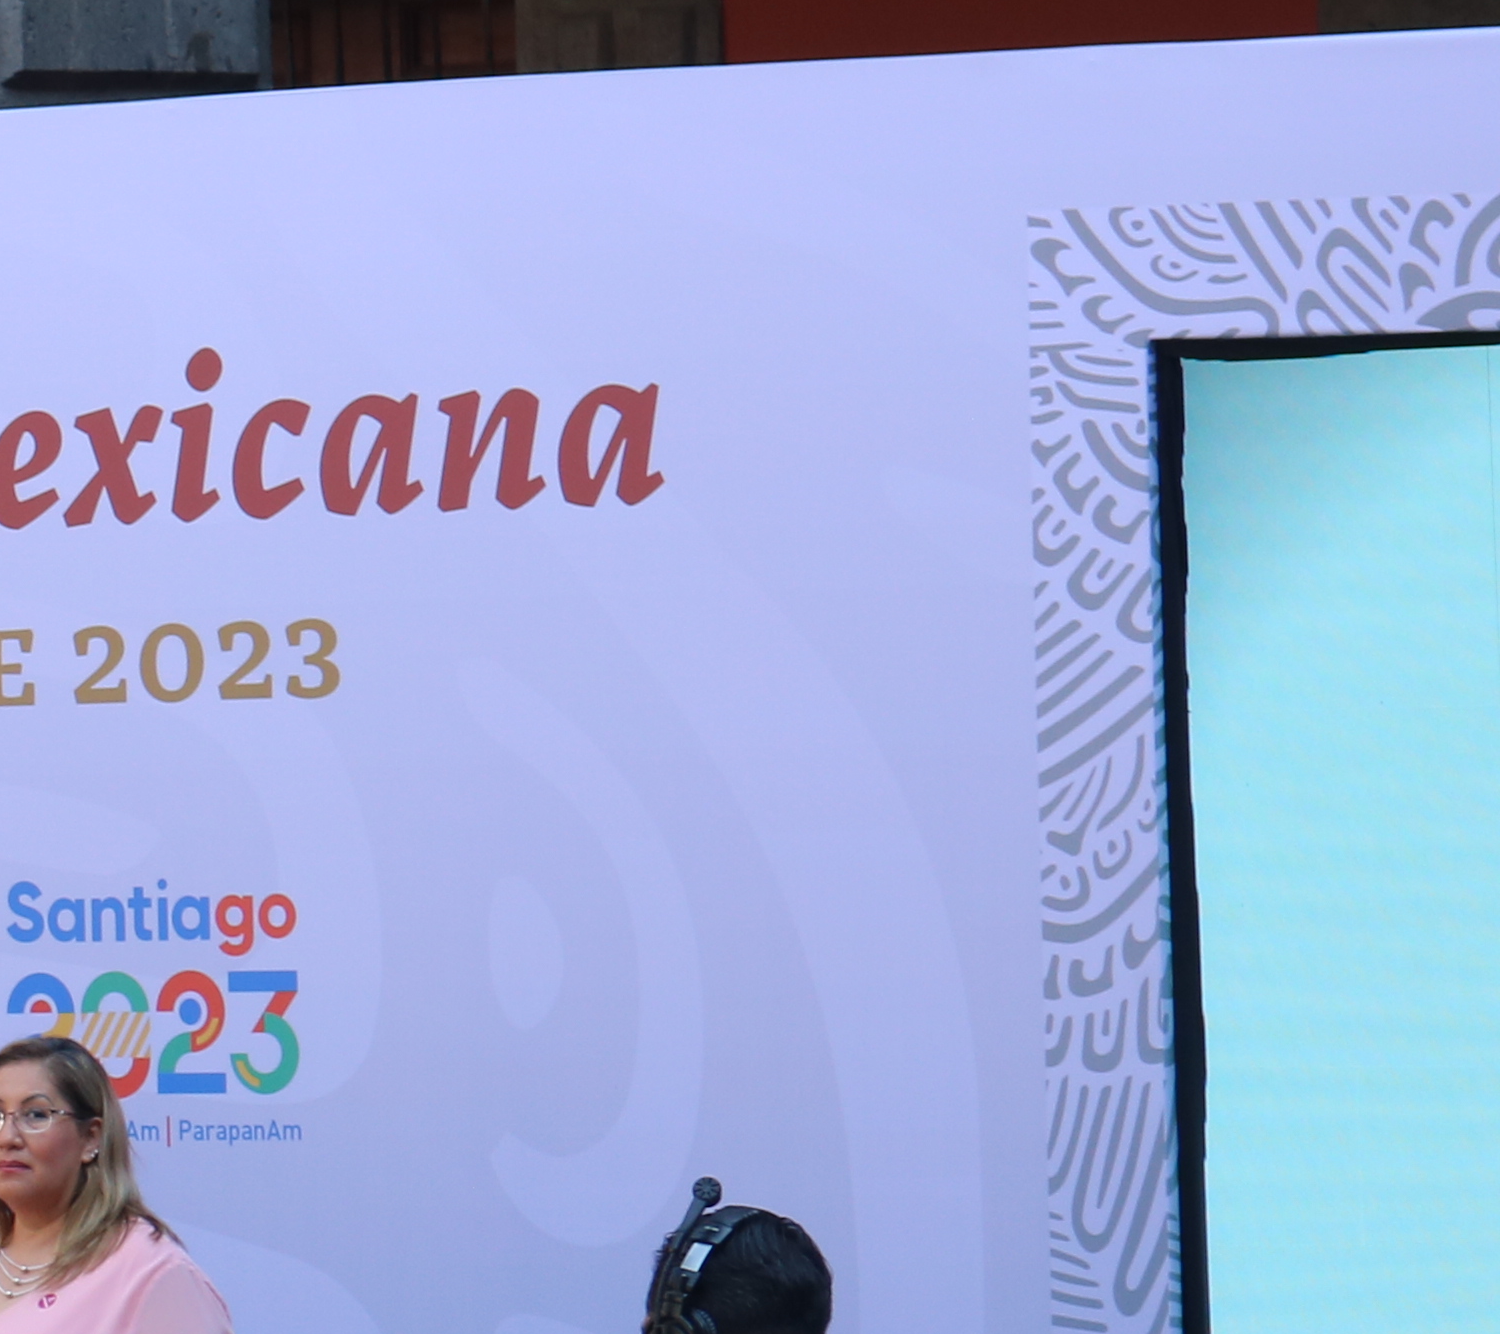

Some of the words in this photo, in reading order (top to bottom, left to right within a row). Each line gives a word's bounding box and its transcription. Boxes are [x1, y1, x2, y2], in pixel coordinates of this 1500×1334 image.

[72, 617, 342, 705] 2023
[6, 878, 298, 957] Santiago
[179, 1119, 302, 1146] ParapanAm
